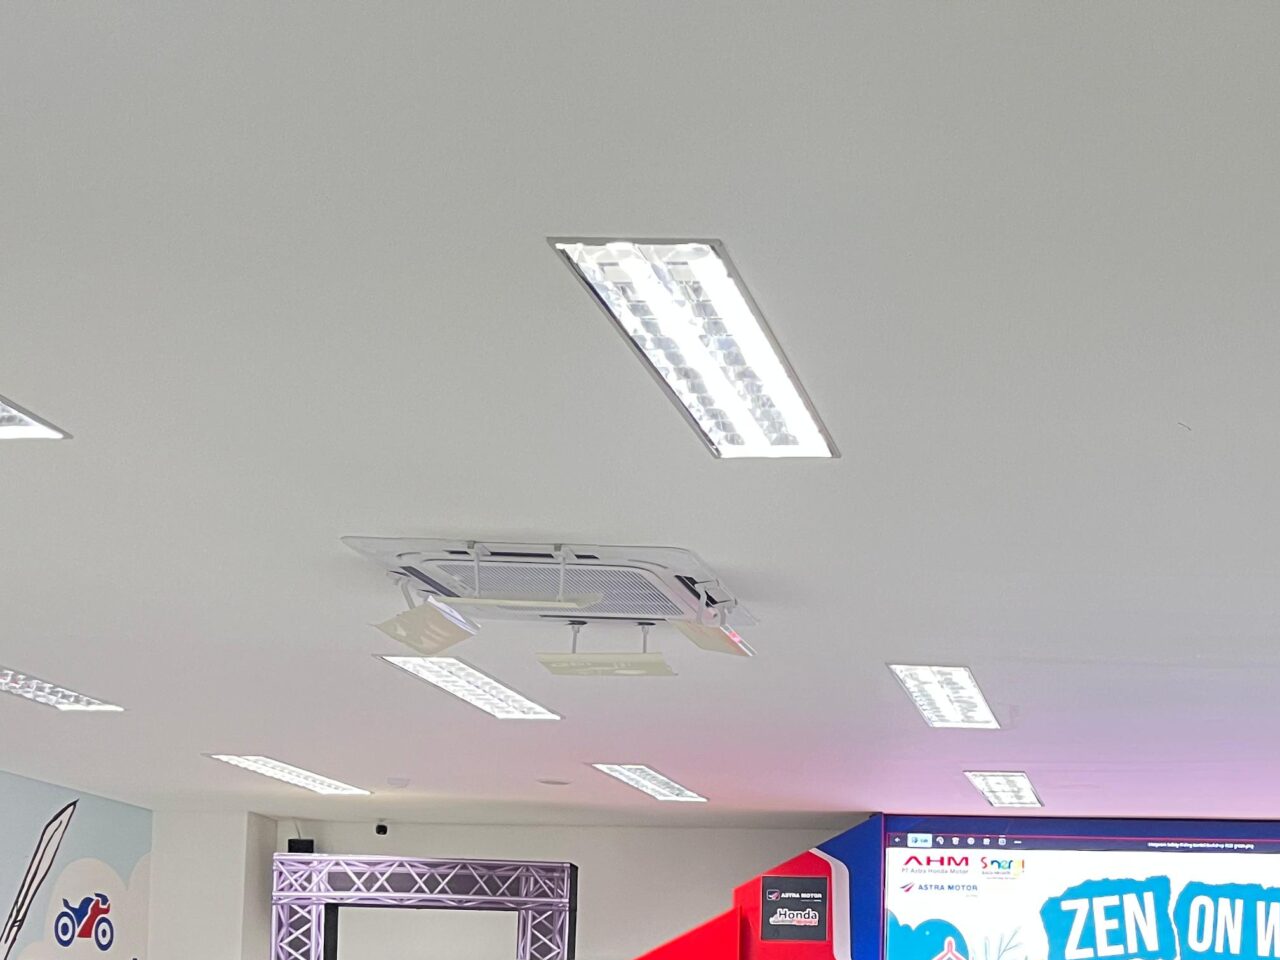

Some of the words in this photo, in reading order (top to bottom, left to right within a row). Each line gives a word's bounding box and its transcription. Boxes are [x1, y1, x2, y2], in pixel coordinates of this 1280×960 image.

[903, 855, 969, 867] AHM
[779, 909, 817, 919] Honda
[1060, 891, 1160, 960] ZEN
[1187, 895, 1244, 955] ON
